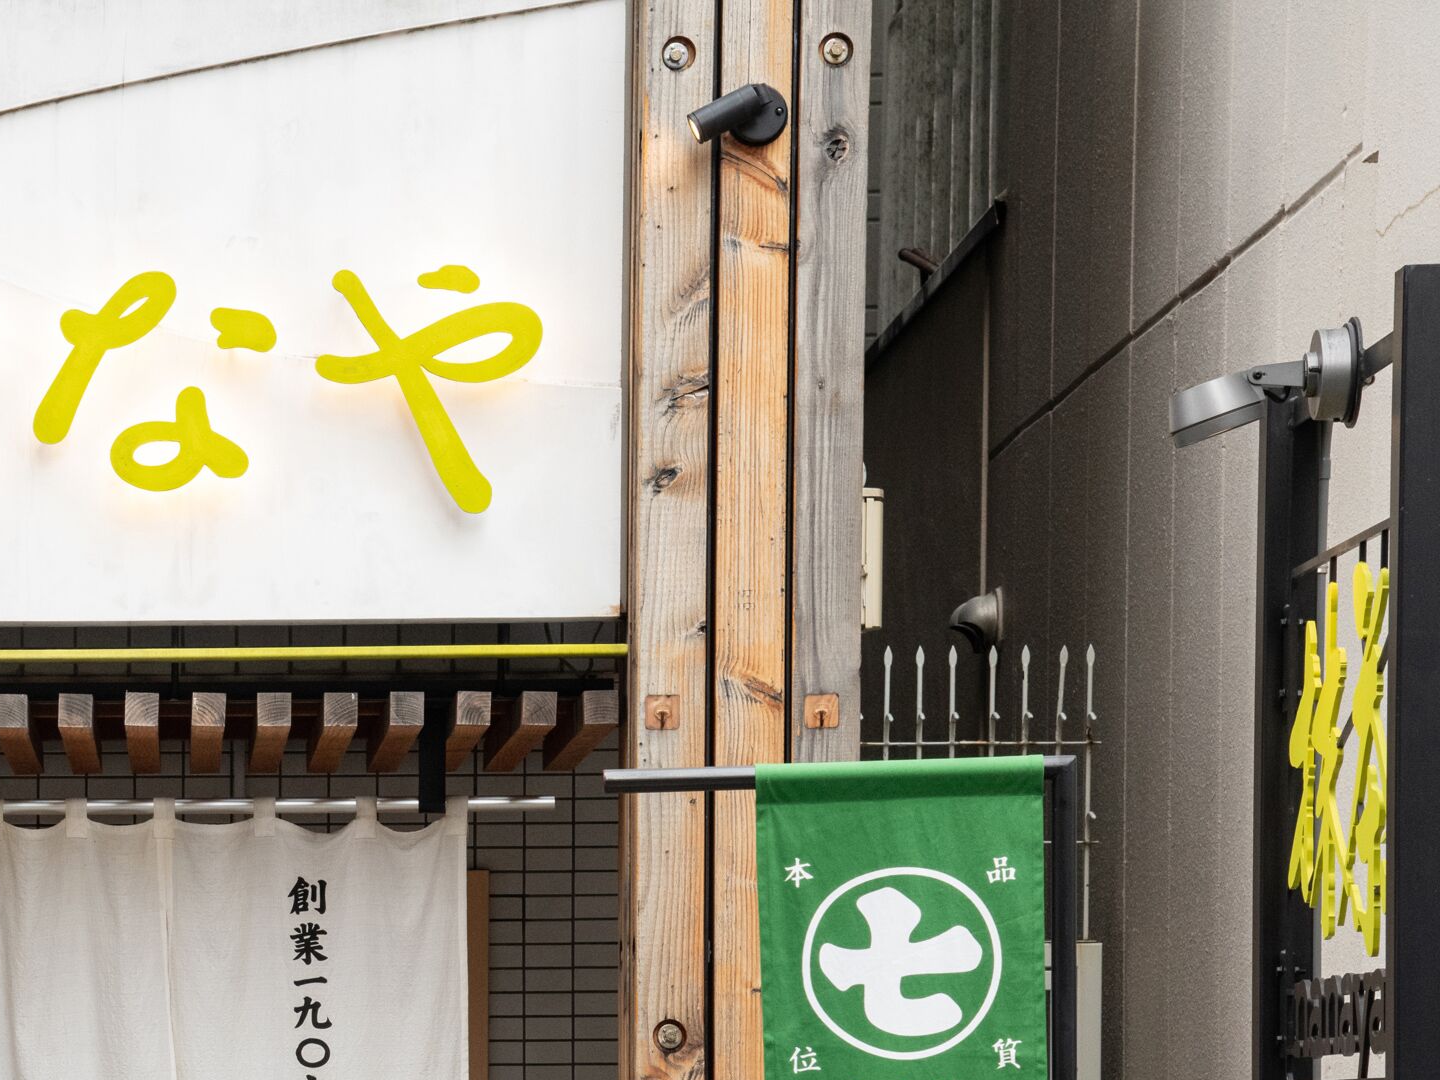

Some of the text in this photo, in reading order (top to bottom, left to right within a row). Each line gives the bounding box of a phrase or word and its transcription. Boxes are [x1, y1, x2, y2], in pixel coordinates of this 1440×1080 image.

[784, 857, 814, 889] 本
[986, 856, 1017, 883] 品
[818, 885, 983, 1037] 七
[789, 1046, 822, 1074] 位
[991, 1037, 1023, 1069] 質
